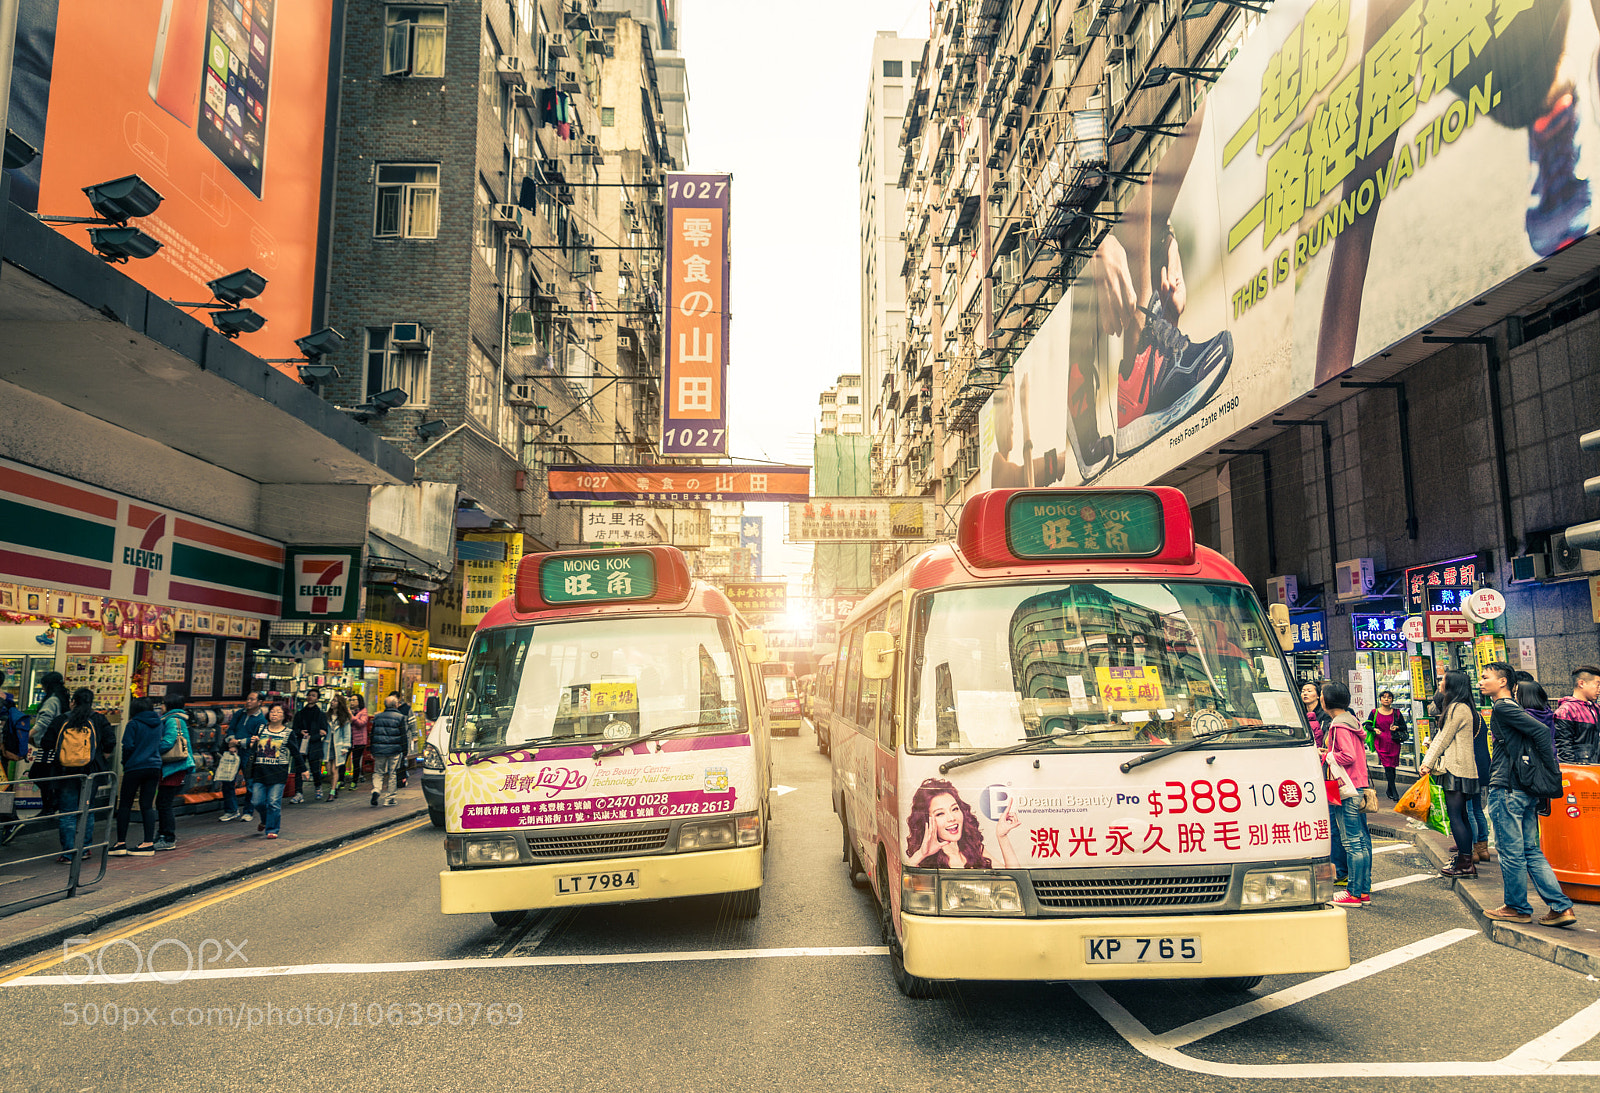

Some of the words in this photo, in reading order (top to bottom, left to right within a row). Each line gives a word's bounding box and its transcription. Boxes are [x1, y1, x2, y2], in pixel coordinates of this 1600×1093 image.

[668, 181, 728, 199] 1027
[1232, 268, 1269, 320] THIS
[1273, 249, 1290, 289] IS
[1294, 70, 1502, 271] RUNNOVATION.
[679, 218, 714, 412] 零食の山田
[1169, 433, 1184, 449] Fresh
[1184, 423, 1201, 439] Foam
[1200, 411, 1219, 430] Zante
[1218, 395, 1241, 420] M1980
[665, 428, 726, 447] 1027
[575, 476, 610, 489] 1027
[636, 473, 768, 493] 零食の山田
[1033, 504, 1079, 517] MONG
[1099, 509, 1132, 522] KOK
[892, 524, 924, 535] Nikon
[1042, 517, 1131, 552] 旺角
[563, 559, 600, 573] MONG
[606, 557, 631, 571] KOK
[564, 571, 632, 596] 旺角
[1358, 630, 1397, 641] iPhone
[1399, 631, 1406, 641] 6
[594, 689, 634, 707] 官塘
[591, 775, 639, 788] Technology
[641, 774, 660, 784] Nail
[660, 772, 695, 783] Services
[595, 768, 611, 778] Pro
[612, 767, 642, 778] Beauty
[643, 765, 671, 774] Centre
[510, 804, 520, 814] 68
[566, 802, 573, 811] 2
[606, 795, 637, 809] 2470
[639, 793, 669, 806] 0028
[1018, 794, 1062, 807] Dream
[1066, 793, 1113, 810] Beauty
[1117, 792, 1140, 805] Pro
[1147, 778, 1242, 818] $388
[563, 813, 573, 823] 17
[630, 809, 635, 818] 1
[669, 802, 700, 816] 2478
[702, 800, 731, 813] 2613
[1030, 821, 1242, 859] 激光永久脫毛
[1248, 818, 1330, 847] 別無他選
[558, 876, 582, 894] LT
[588, 871, 636, 891] 7984
[1090, 938, 1122, 960] KP
[1136, 937, 1197, 960] 765
